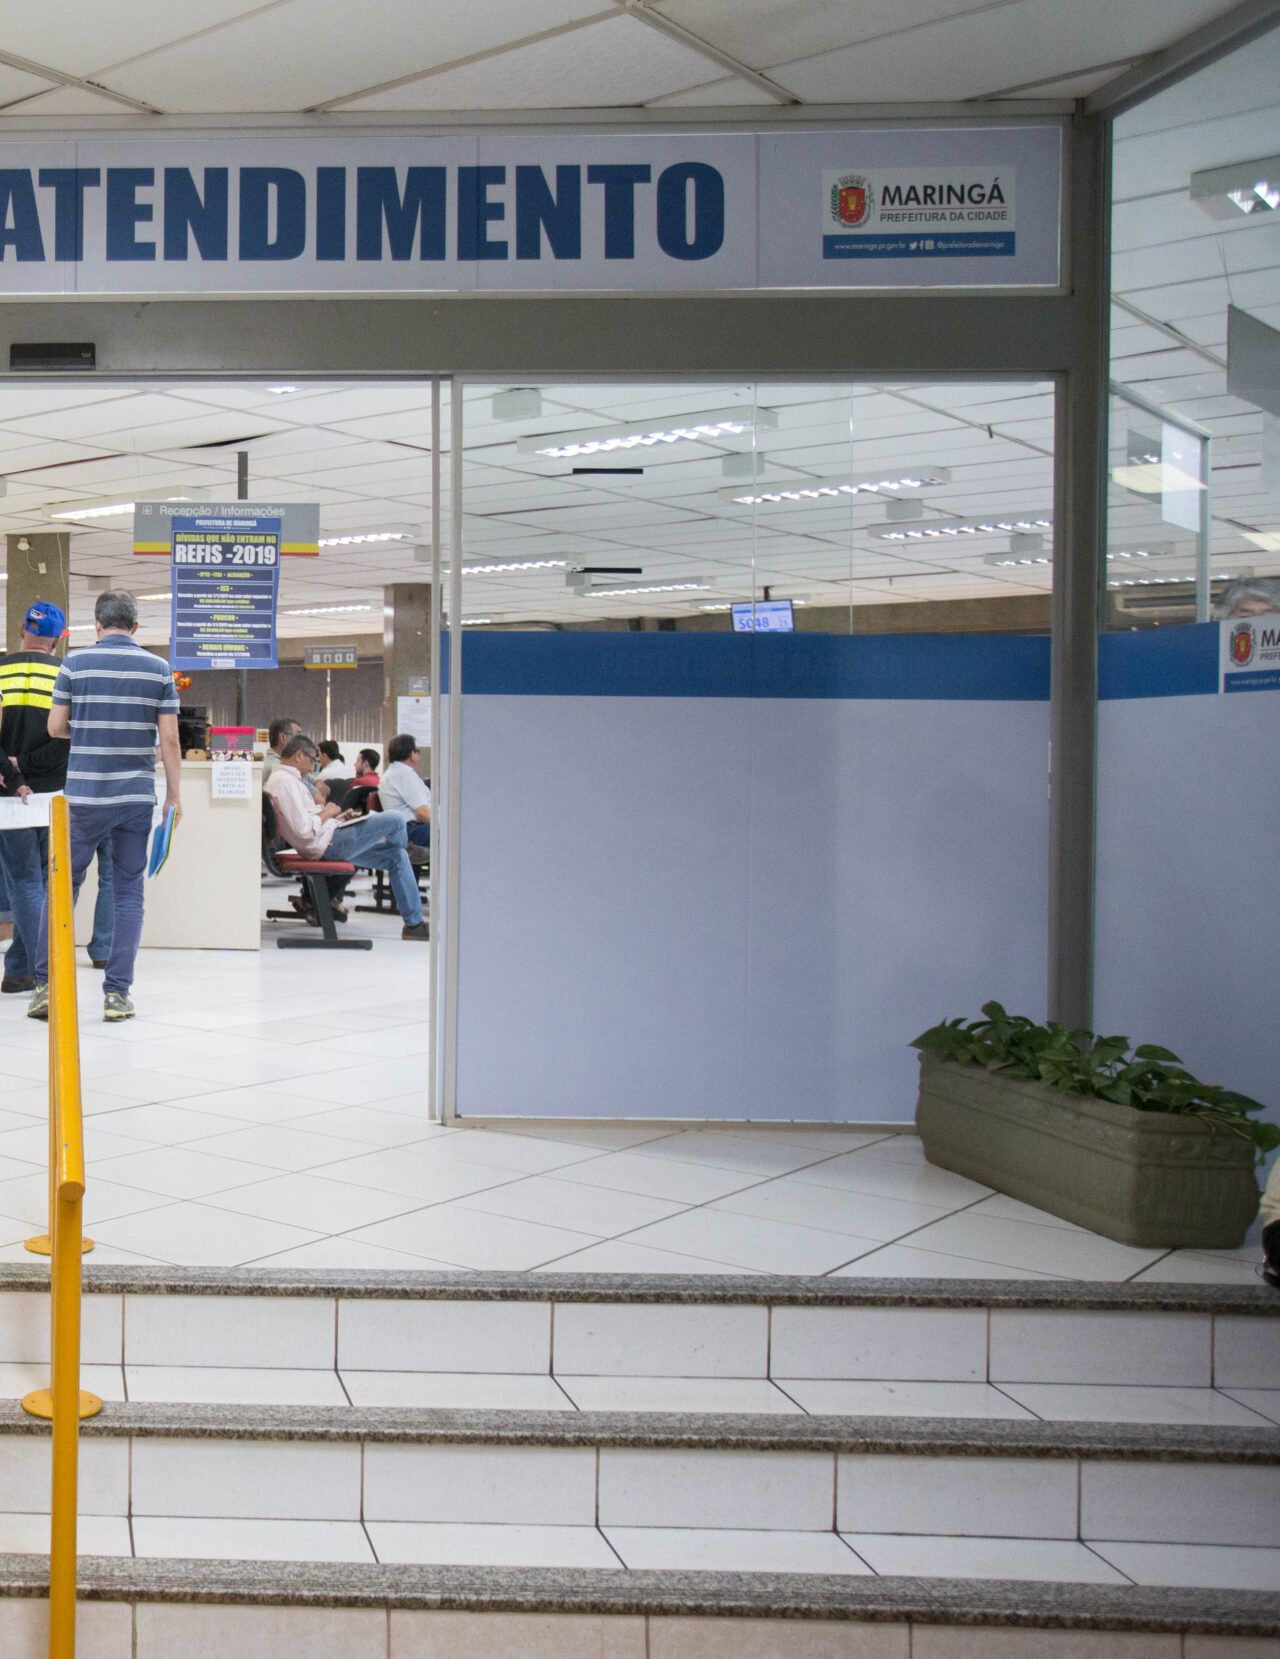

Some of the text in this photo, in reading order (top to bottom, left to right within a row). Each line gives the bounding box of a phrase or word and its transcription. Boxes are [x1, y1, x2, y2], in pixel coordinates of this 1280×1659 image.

[881, 176, 1005, 206] MARINGÁ
[880, 210, 1007, 222] PREFEITURA DA CIDADE
[159, 505, 212, 517] Recepção
[221, 506, 286, 517] Informações
[175, 532, 276, 544] DÍVIDAS QUE NÃO ENTRAM NO
[175, 544, 223, 564] REFIS
